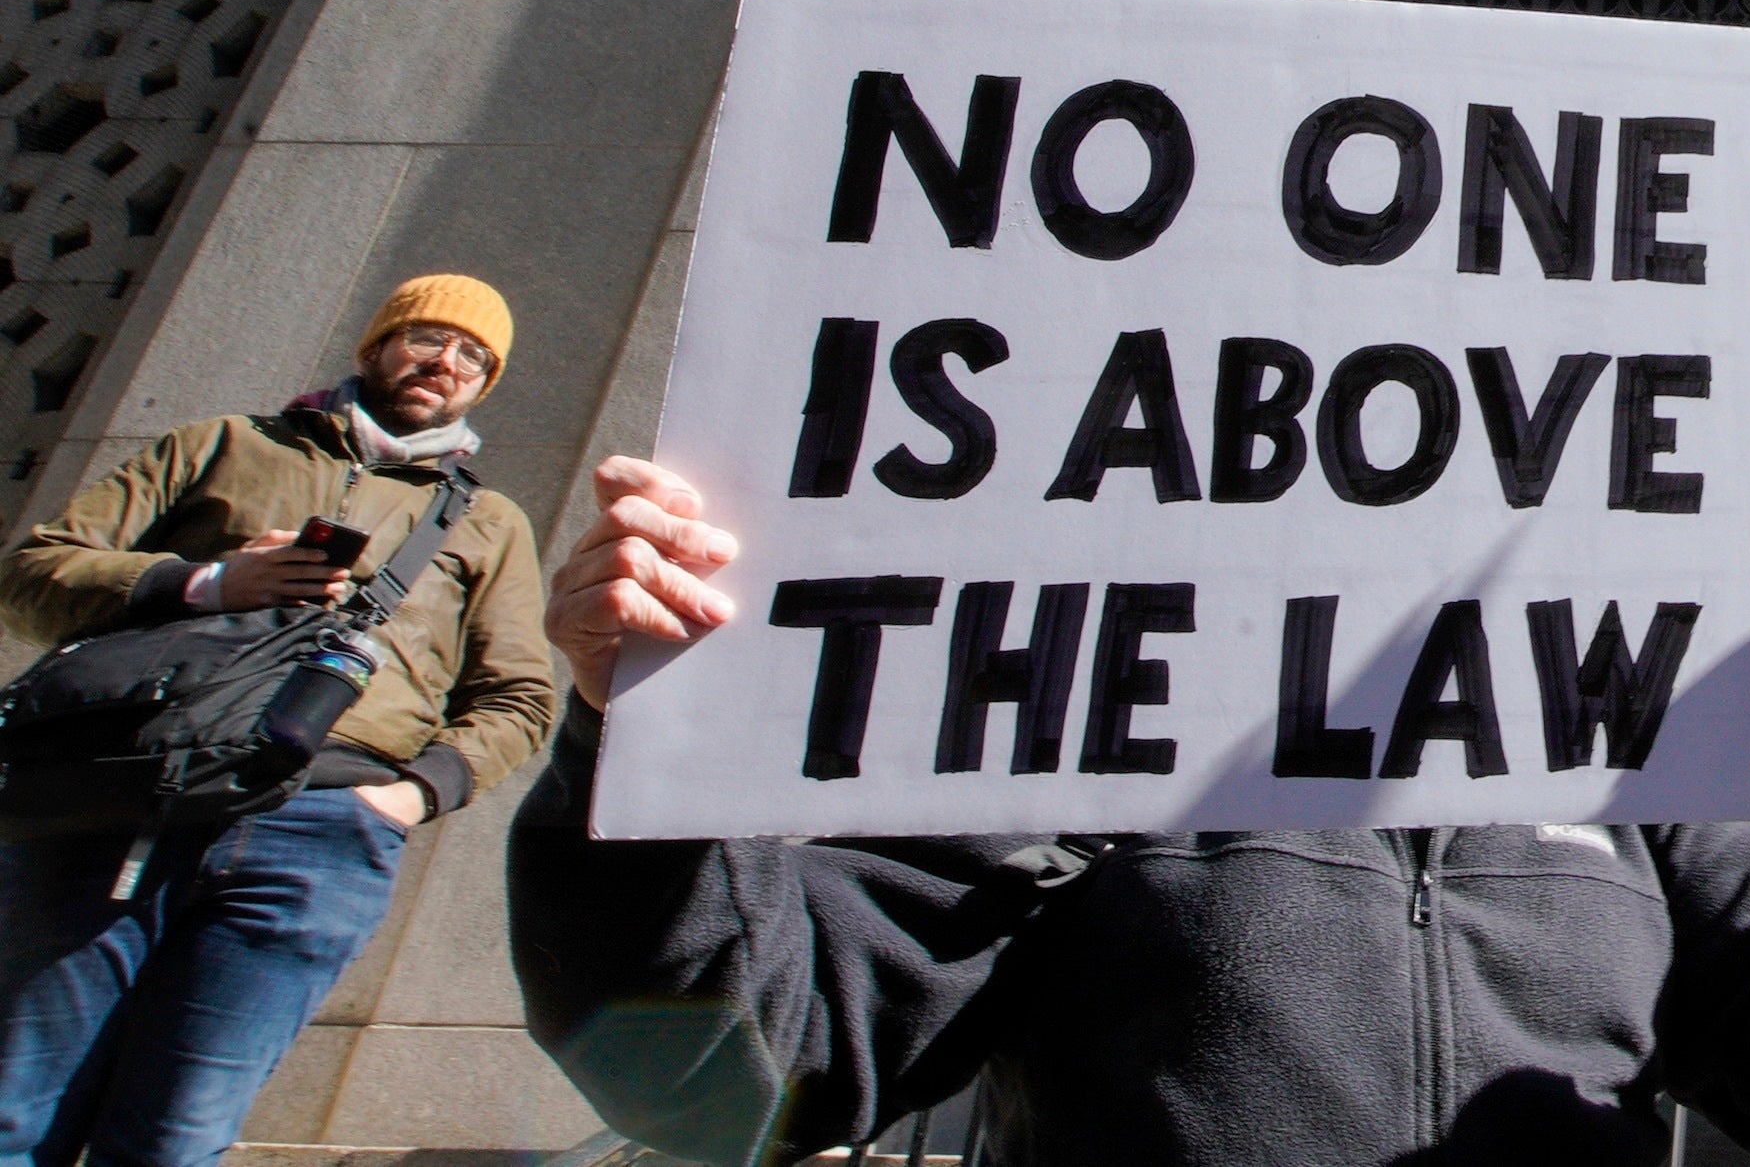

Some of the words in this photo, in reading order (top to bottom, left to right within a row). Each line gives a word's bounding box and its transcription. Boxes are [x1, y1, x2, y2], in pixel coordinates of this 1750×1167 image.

[826, 69, 1195, 262] NO
[1282, 94, 1716, 286] ONE
[787, 316, 1010, 501] IS
[1045, 327, 1713, 515] ABOVE
[767, 574, 1196, 782] THE
[1271, 594, 1704, 782] LAW
